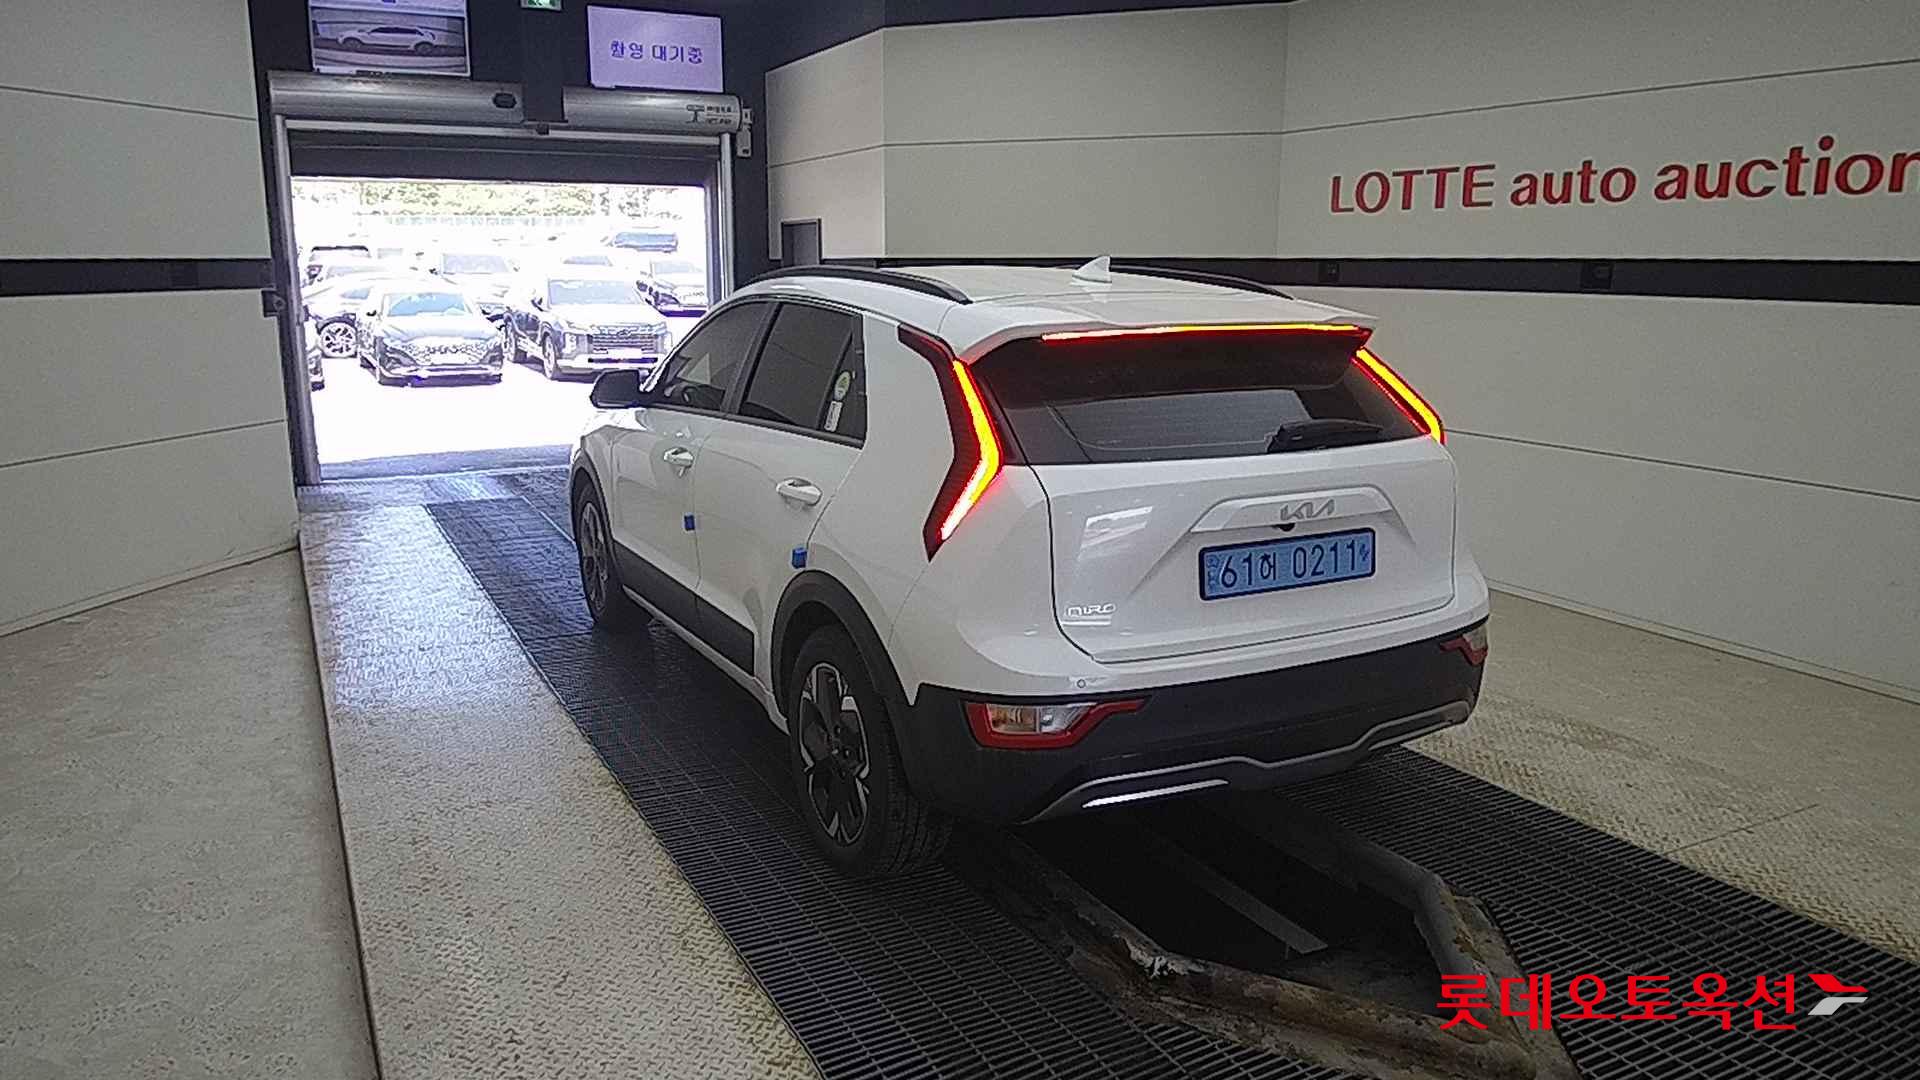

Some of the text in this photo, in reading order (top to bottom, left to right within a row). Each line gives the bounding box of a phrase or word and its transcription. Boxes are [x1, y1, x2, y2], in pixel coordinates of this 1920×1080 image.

[652, 44, 703, 65] 대기중
[1331, 164, 1496, 213] LOTTE
[1510, 160, 1636, 206] auto
[1280, 500, 1334, 521] KIA
[1293, 540, 1356, 578] 0211
